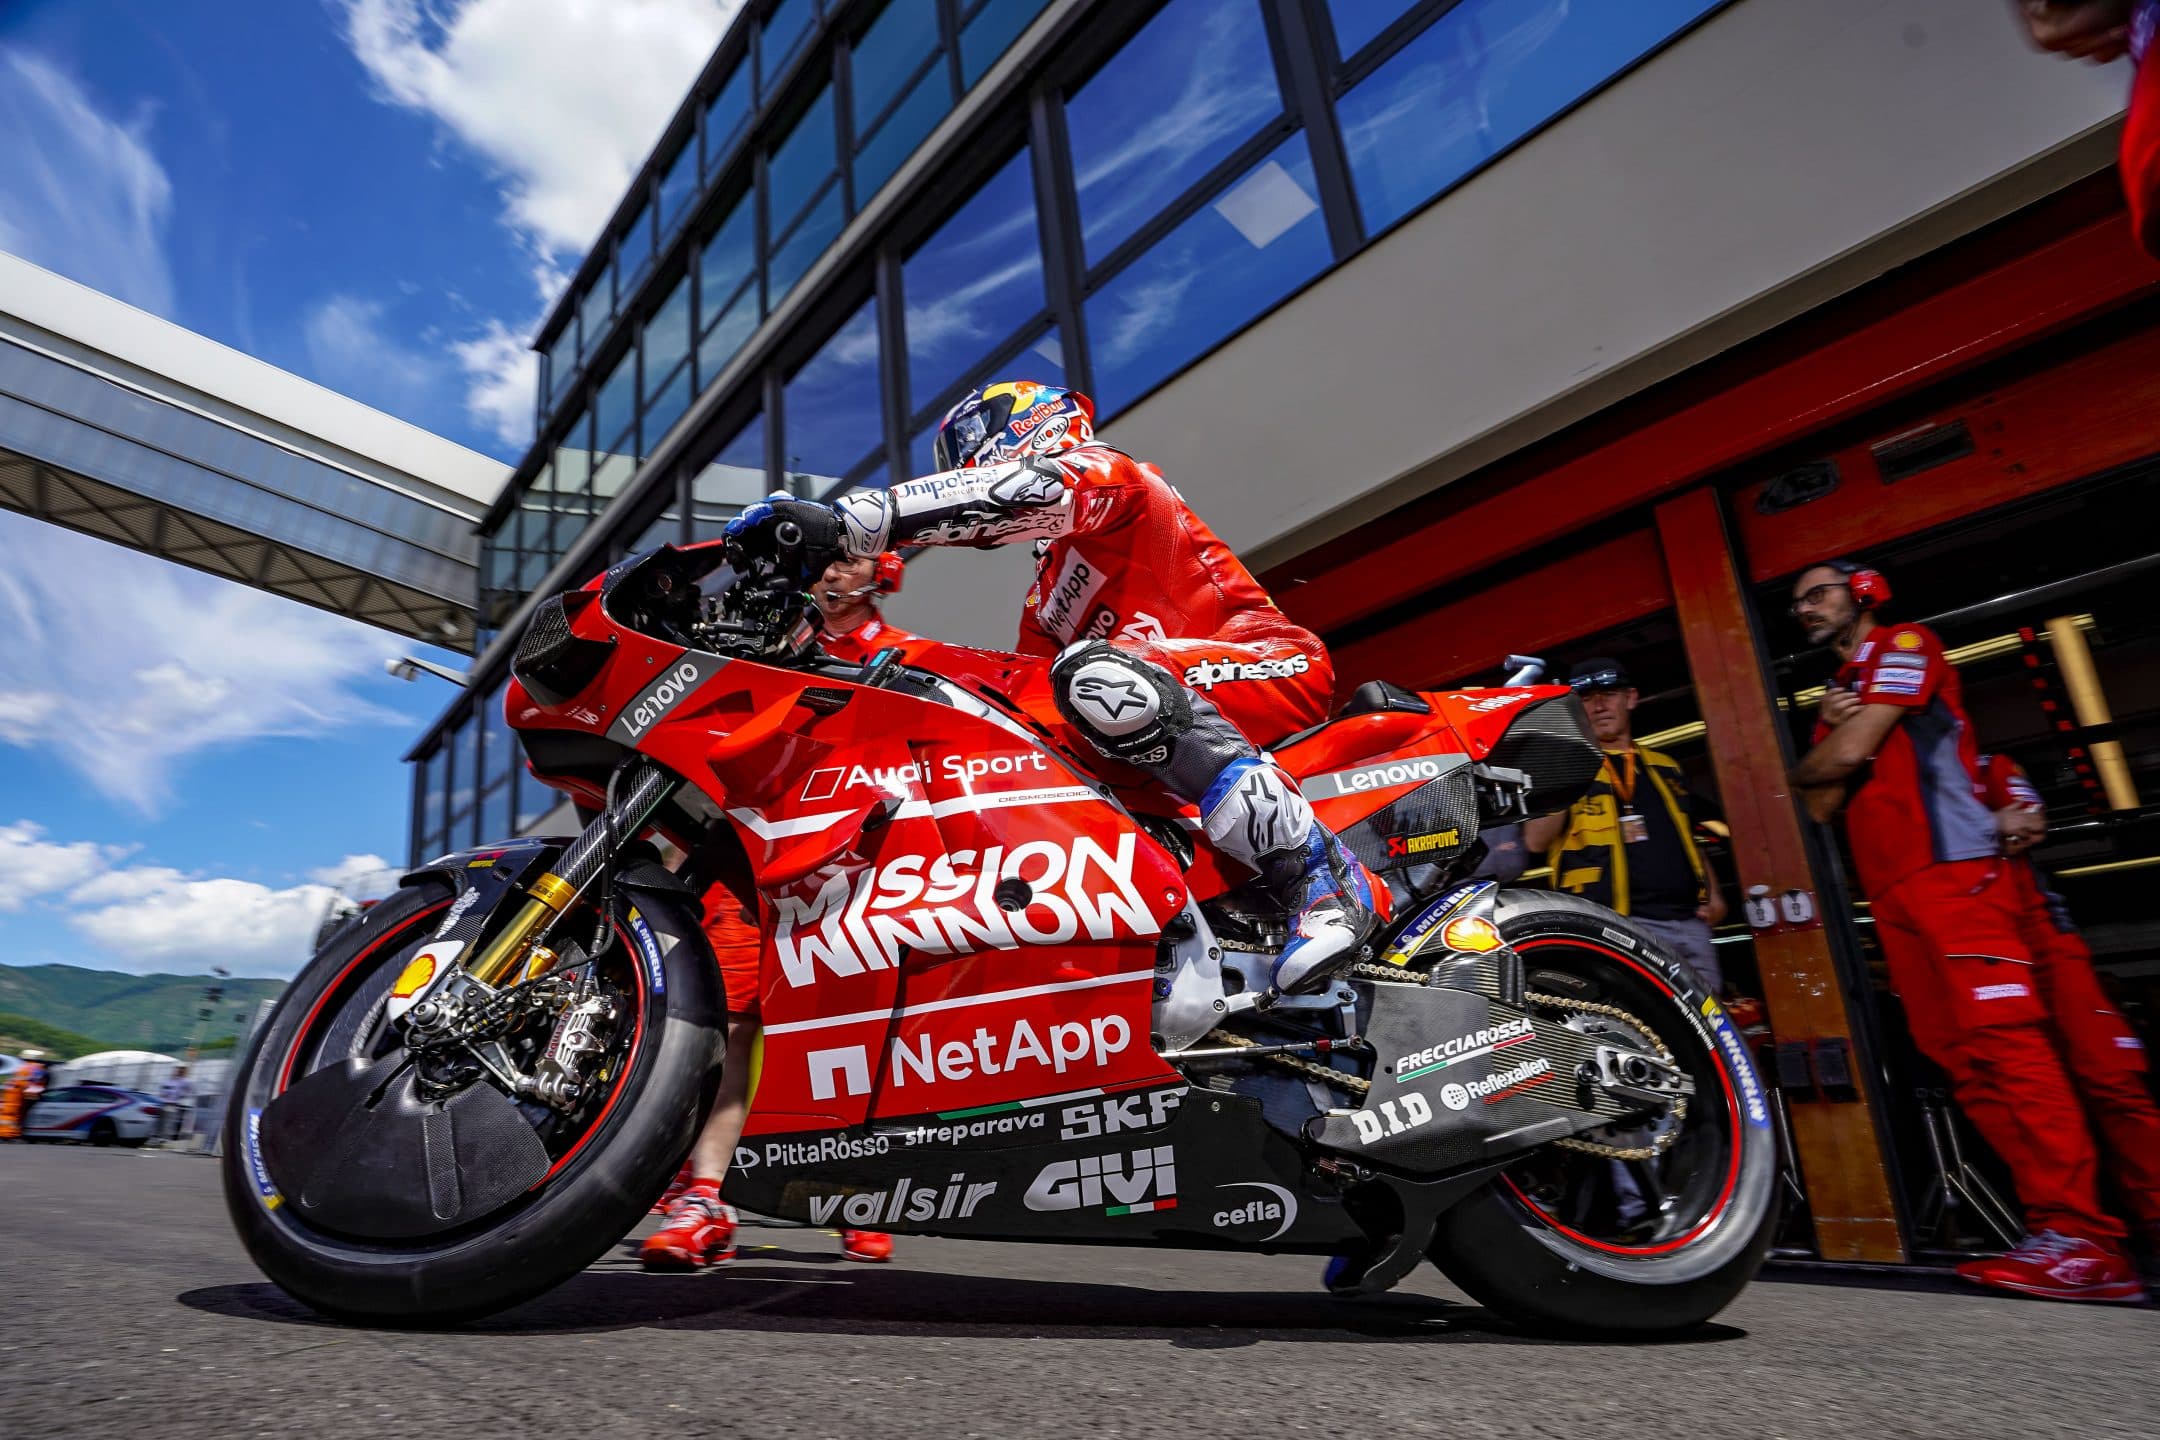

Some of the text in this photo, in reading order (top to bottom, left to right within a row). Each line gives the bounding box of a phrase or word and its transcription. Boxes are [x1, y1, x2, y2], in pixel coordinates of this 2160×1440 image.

[1010, 408, 1043, 437] Red
[1048, 563, 1090, 632] NetApp
[621, 663, 698, 738] Lenovo
[845, 750, 1046, 790] Audi Sport
[1333, 761, 1439, 794] Lenovo
[773, 832, 1137, 933] MISSION
[1416, 883, 1478, 933] MICHELIN
[640, 928, 663, 987] MICHELIN
[774, 888, 1161, 988] WINNOW
[891, 1014, 1131, 1087] NetApp
[1396, 1018, 1533, 1073] FRECCIAROSSA
[1465, 1057, 1550, 1098] Reflexallen
[1719, 1030, 1766, 1121] MICHELIN
[905, 1113, 1044, 1146] streparava
[1061, 1086, 1188, 1141] SKF
[1350, 1092, 1432, 1146] D.I.D
[765, 1135, 889, 1168] PittaRosso
[1023, 1145, 1177, 1211] GIVI
[809, 1172, 997, 1227] valsir
[1213, 1200, 1281, 1228] cefla
